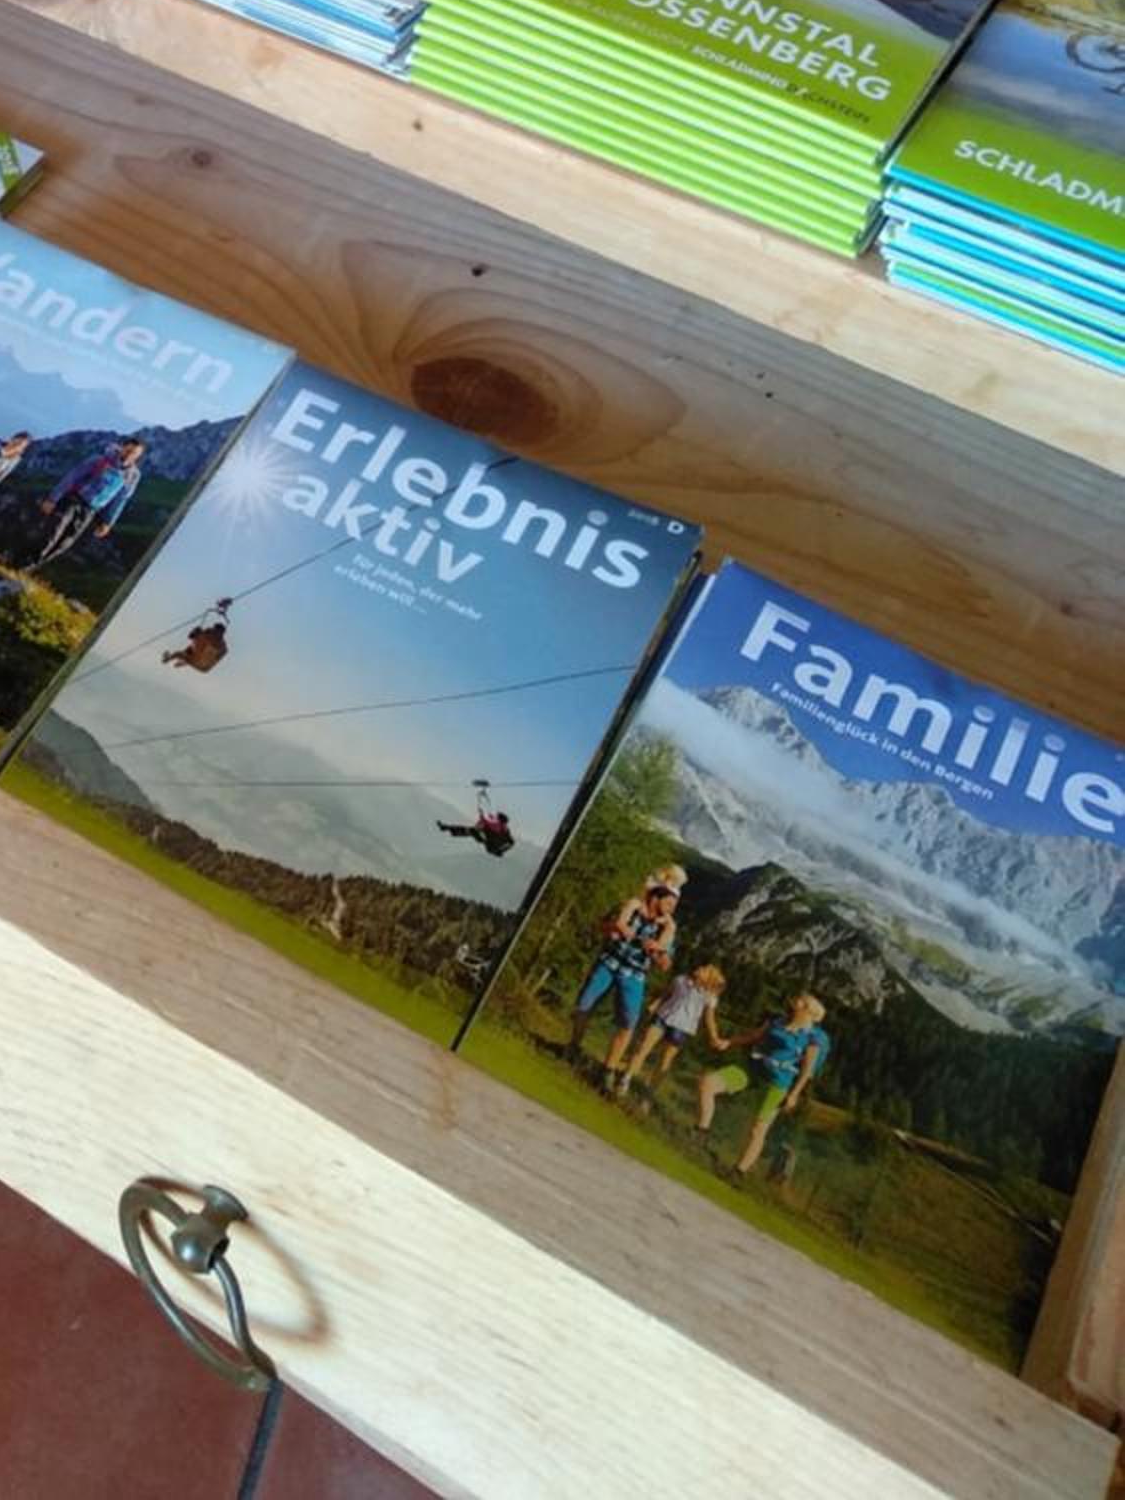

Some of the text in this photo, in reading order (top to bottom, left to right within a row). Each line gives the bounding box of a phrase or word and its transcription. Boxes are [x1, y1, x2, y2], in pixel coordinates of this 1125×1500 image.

[953, 139, 1125, 219] SCHLADM
[270, 387, 650, 589] Erlebnis
[279, 472, 485, 584] aktiv
[738, 600, 1125, 834] Familie
[769, 680, 994, 801] Familienglück in den Bergen
